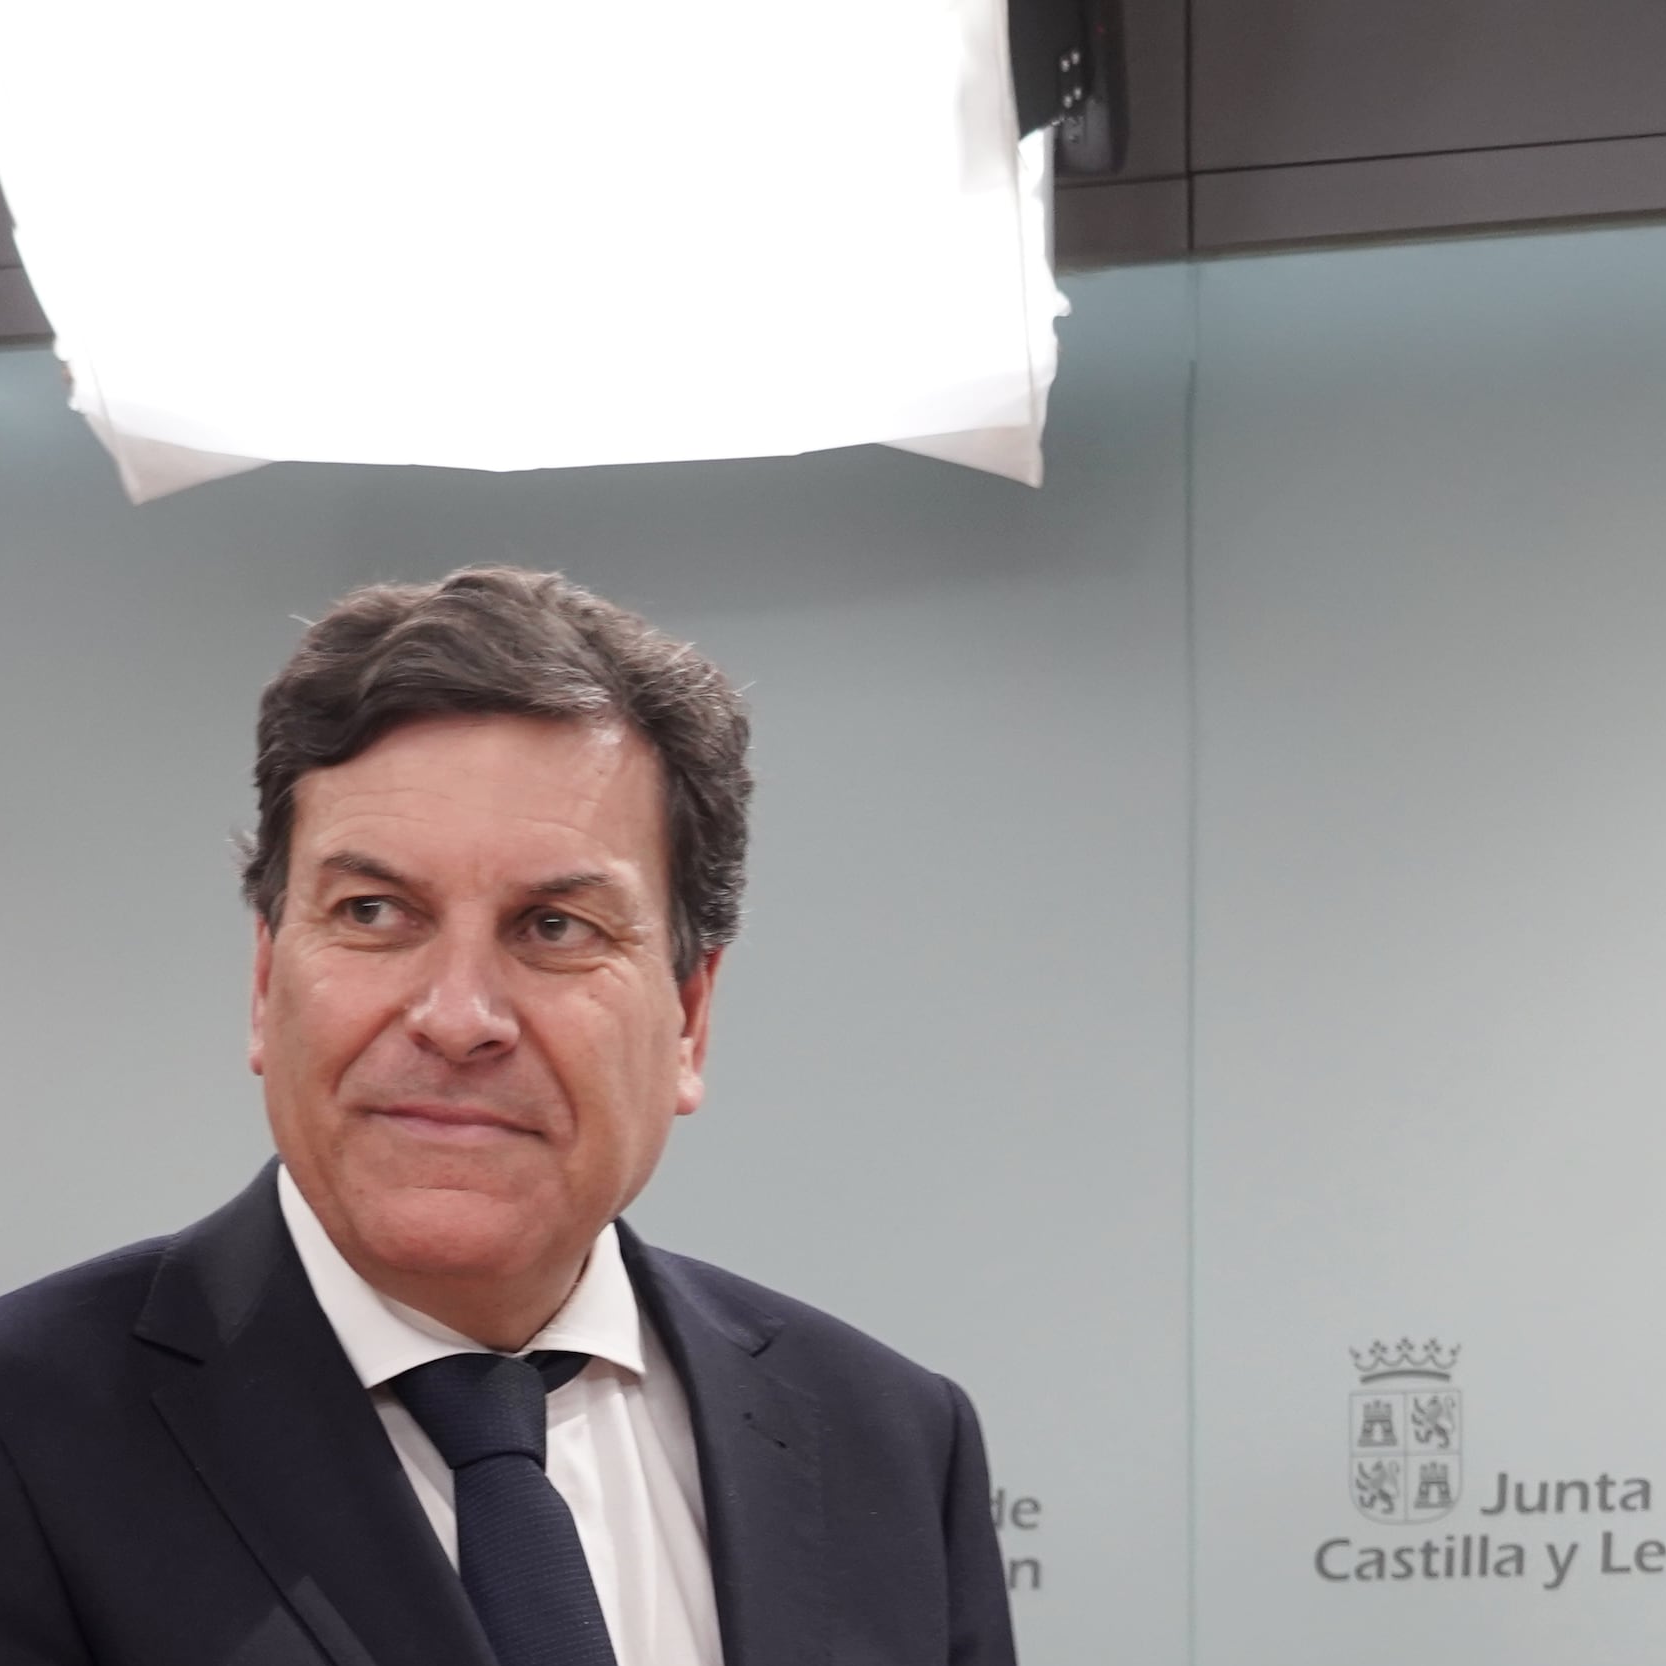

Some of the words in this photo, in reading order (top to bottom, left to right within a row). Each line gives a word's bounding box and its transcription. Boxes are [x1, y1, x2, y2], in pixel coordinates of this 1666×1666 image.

[1479, 1471, 1652, 1518] Junta
[1313, 1533, 1527, 1584] Castilla
[1542, 1541, 1580, 1592] y
